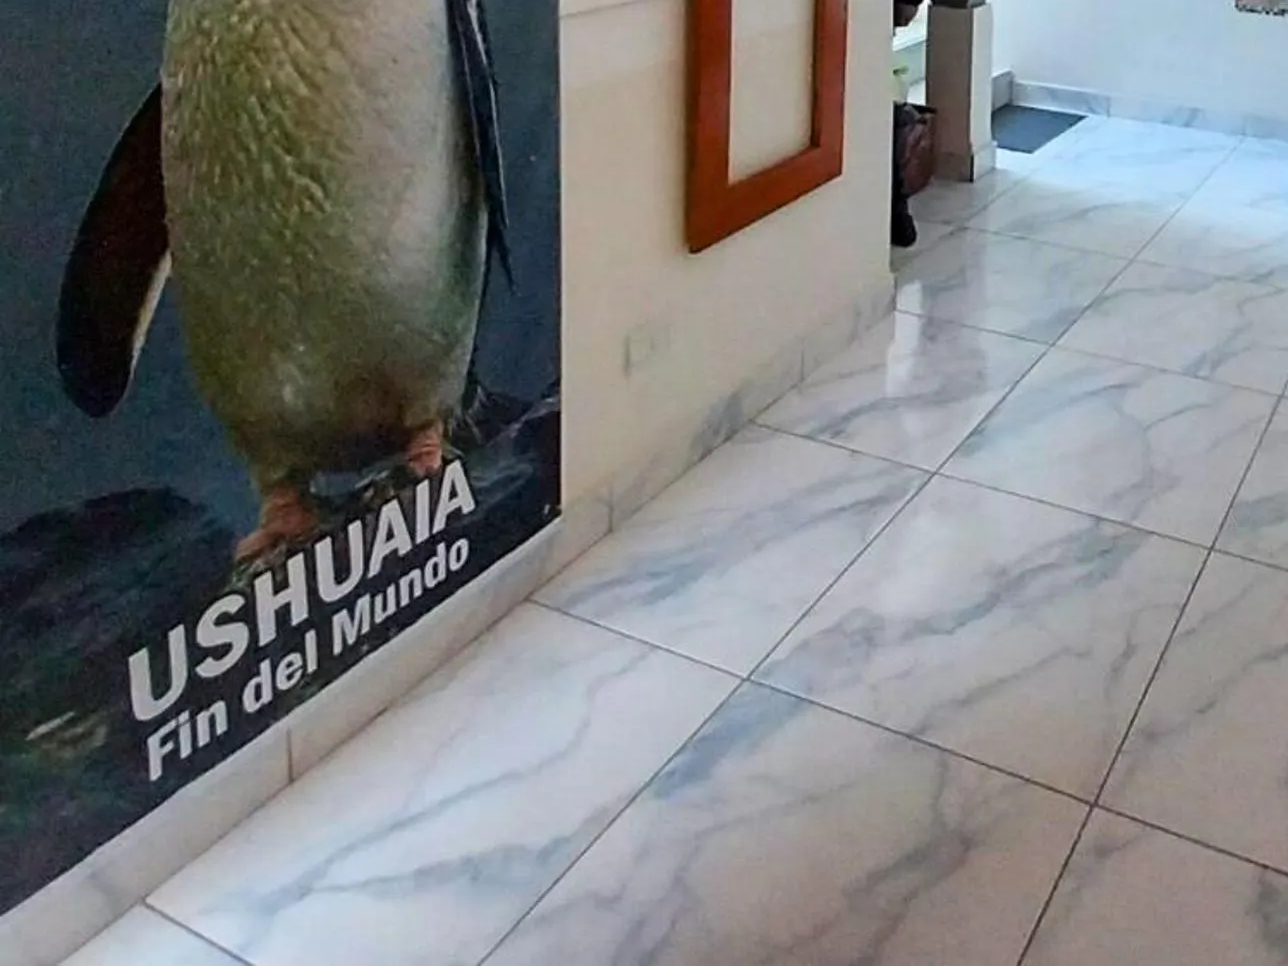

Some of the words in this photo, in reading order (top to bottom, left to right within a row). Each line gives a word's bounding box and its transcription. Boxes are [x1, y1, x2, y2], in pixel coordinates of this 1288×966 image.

[128, 459, 476, 722] USHUAIA
[146, 699, 228, 782] Fin
[242, 629, 317, 713] del
[332, 537, 470, 656] Mundo
